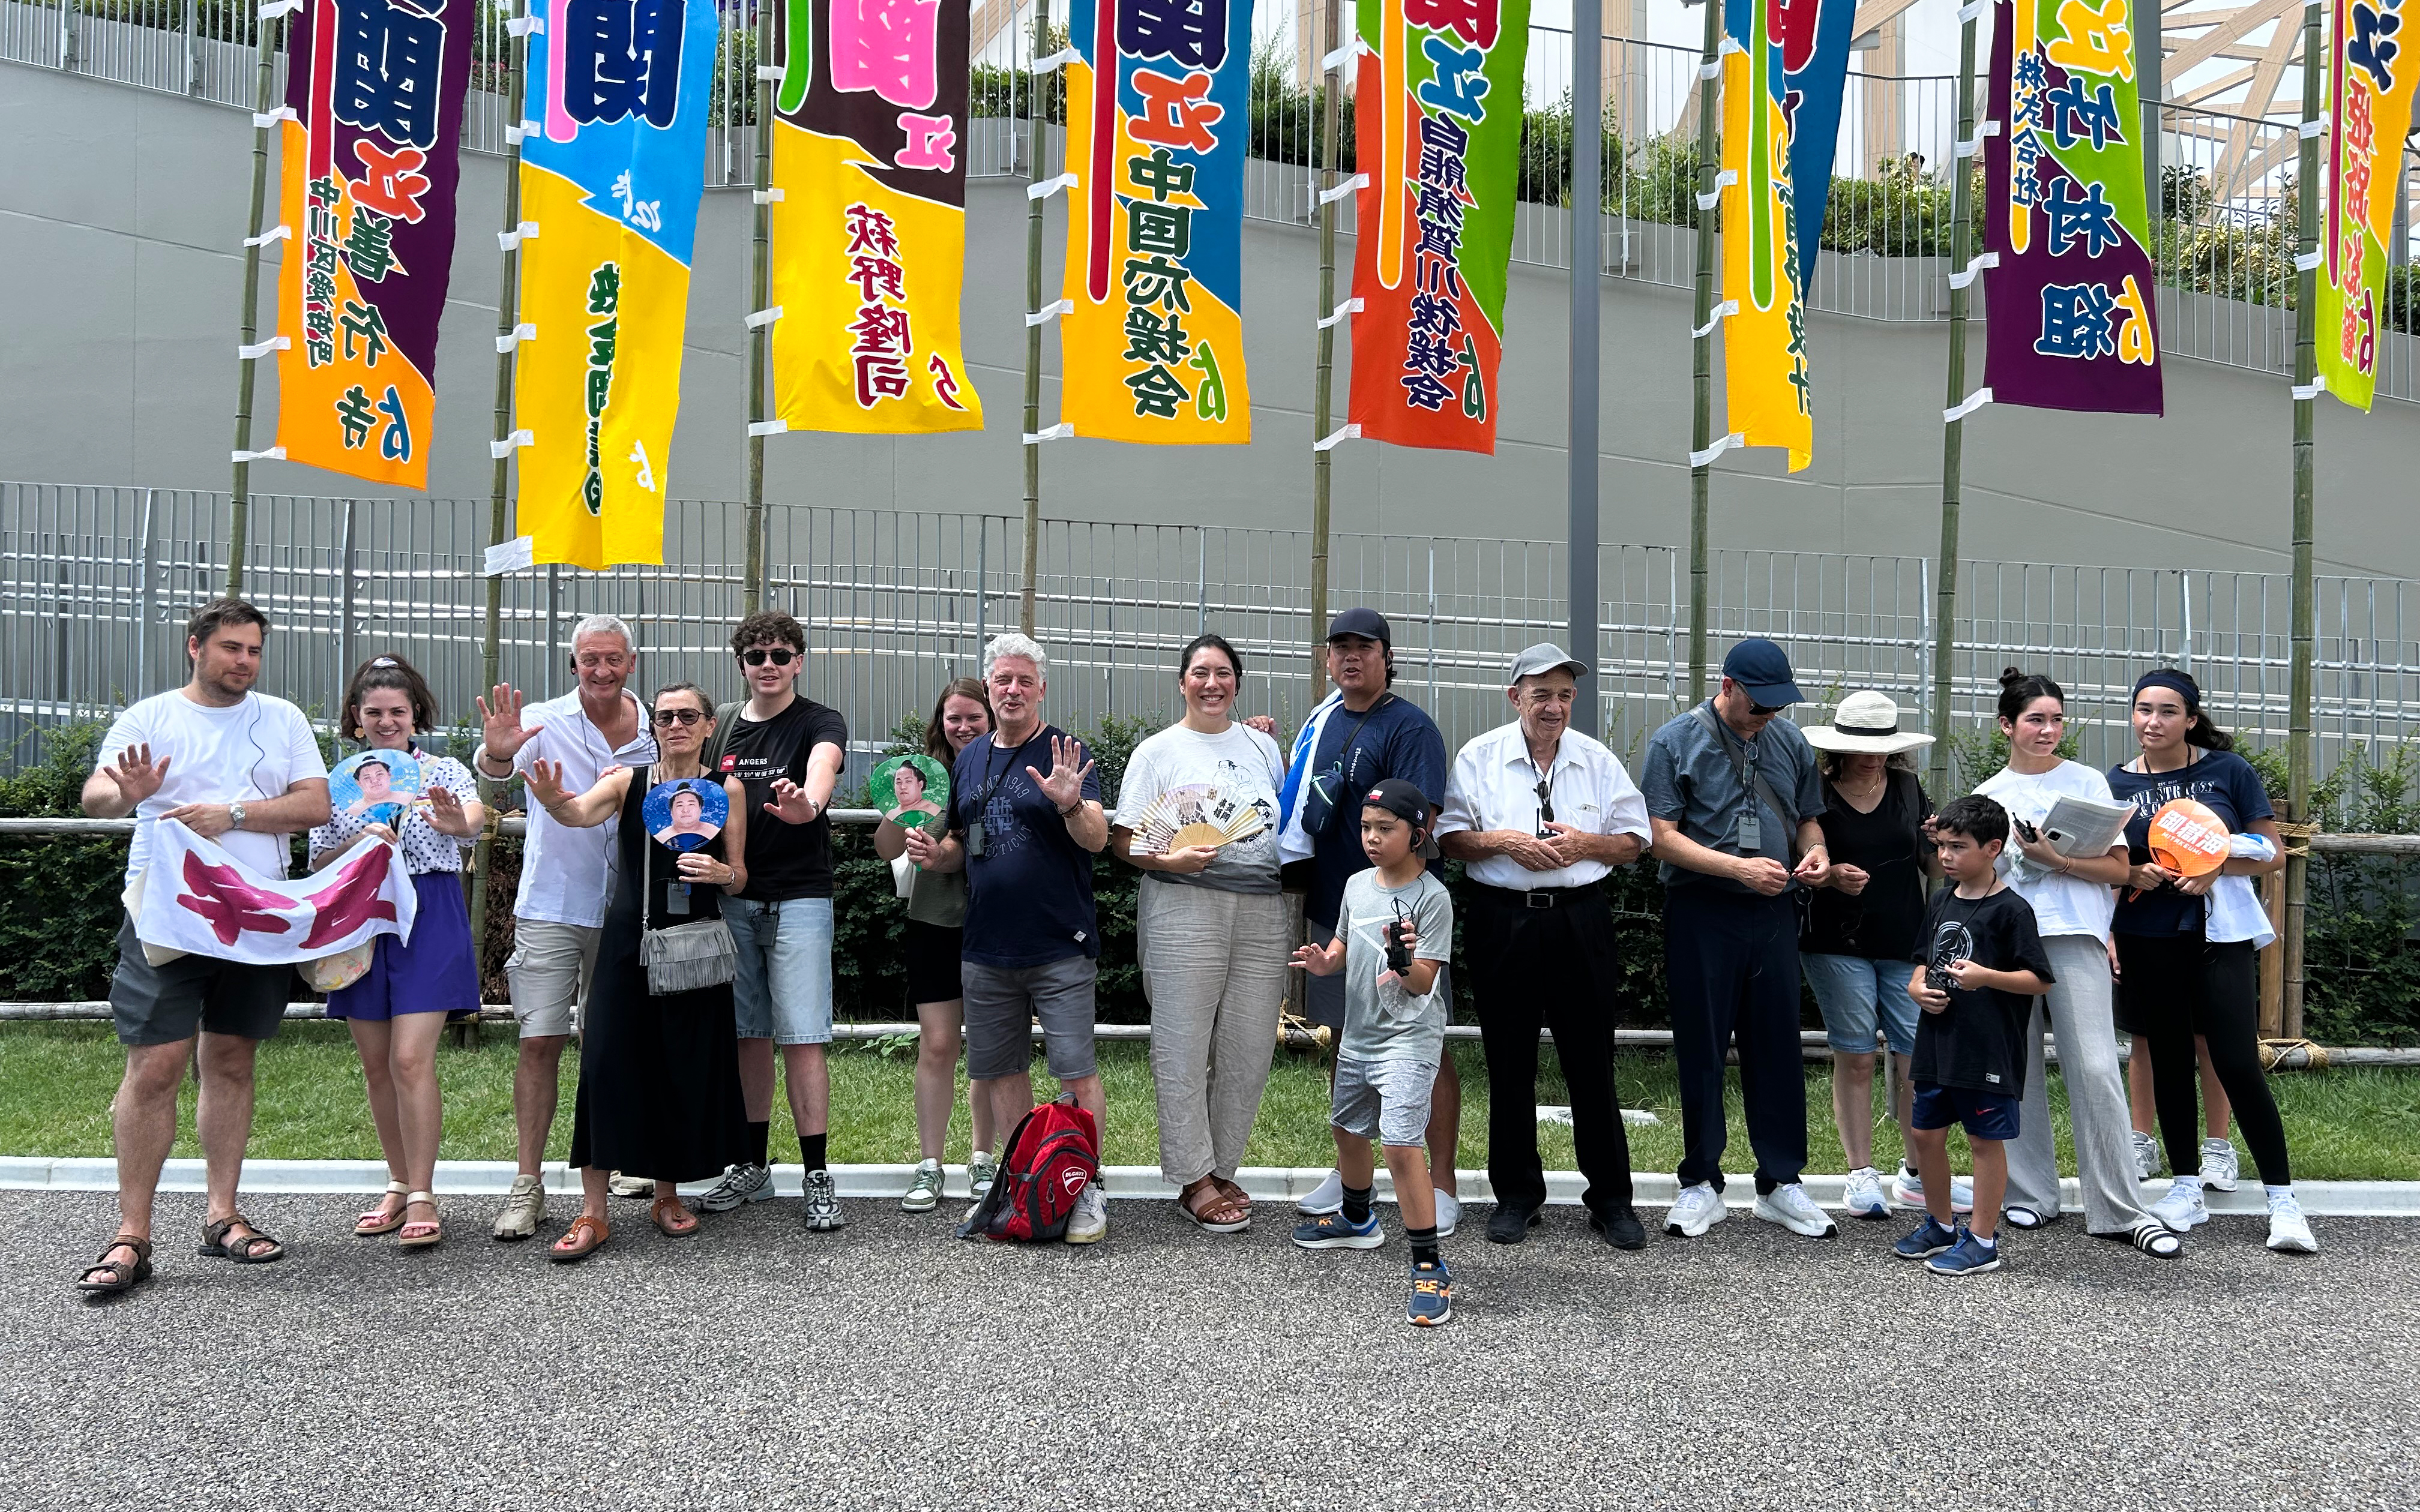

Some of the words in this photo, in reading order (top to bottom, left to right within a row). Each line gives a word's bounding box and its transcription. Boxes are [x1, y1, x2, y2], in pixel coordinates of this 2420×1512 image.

[971, 775, 1001, 801] GANT
[1004, 775, 1029, 799] 1949
[985, 825, 1032, 857] ECTICUT
[2156, 809, 2229, 855] 御嶽海
[2161, 832, 2203, 856] MITAKEUMI
